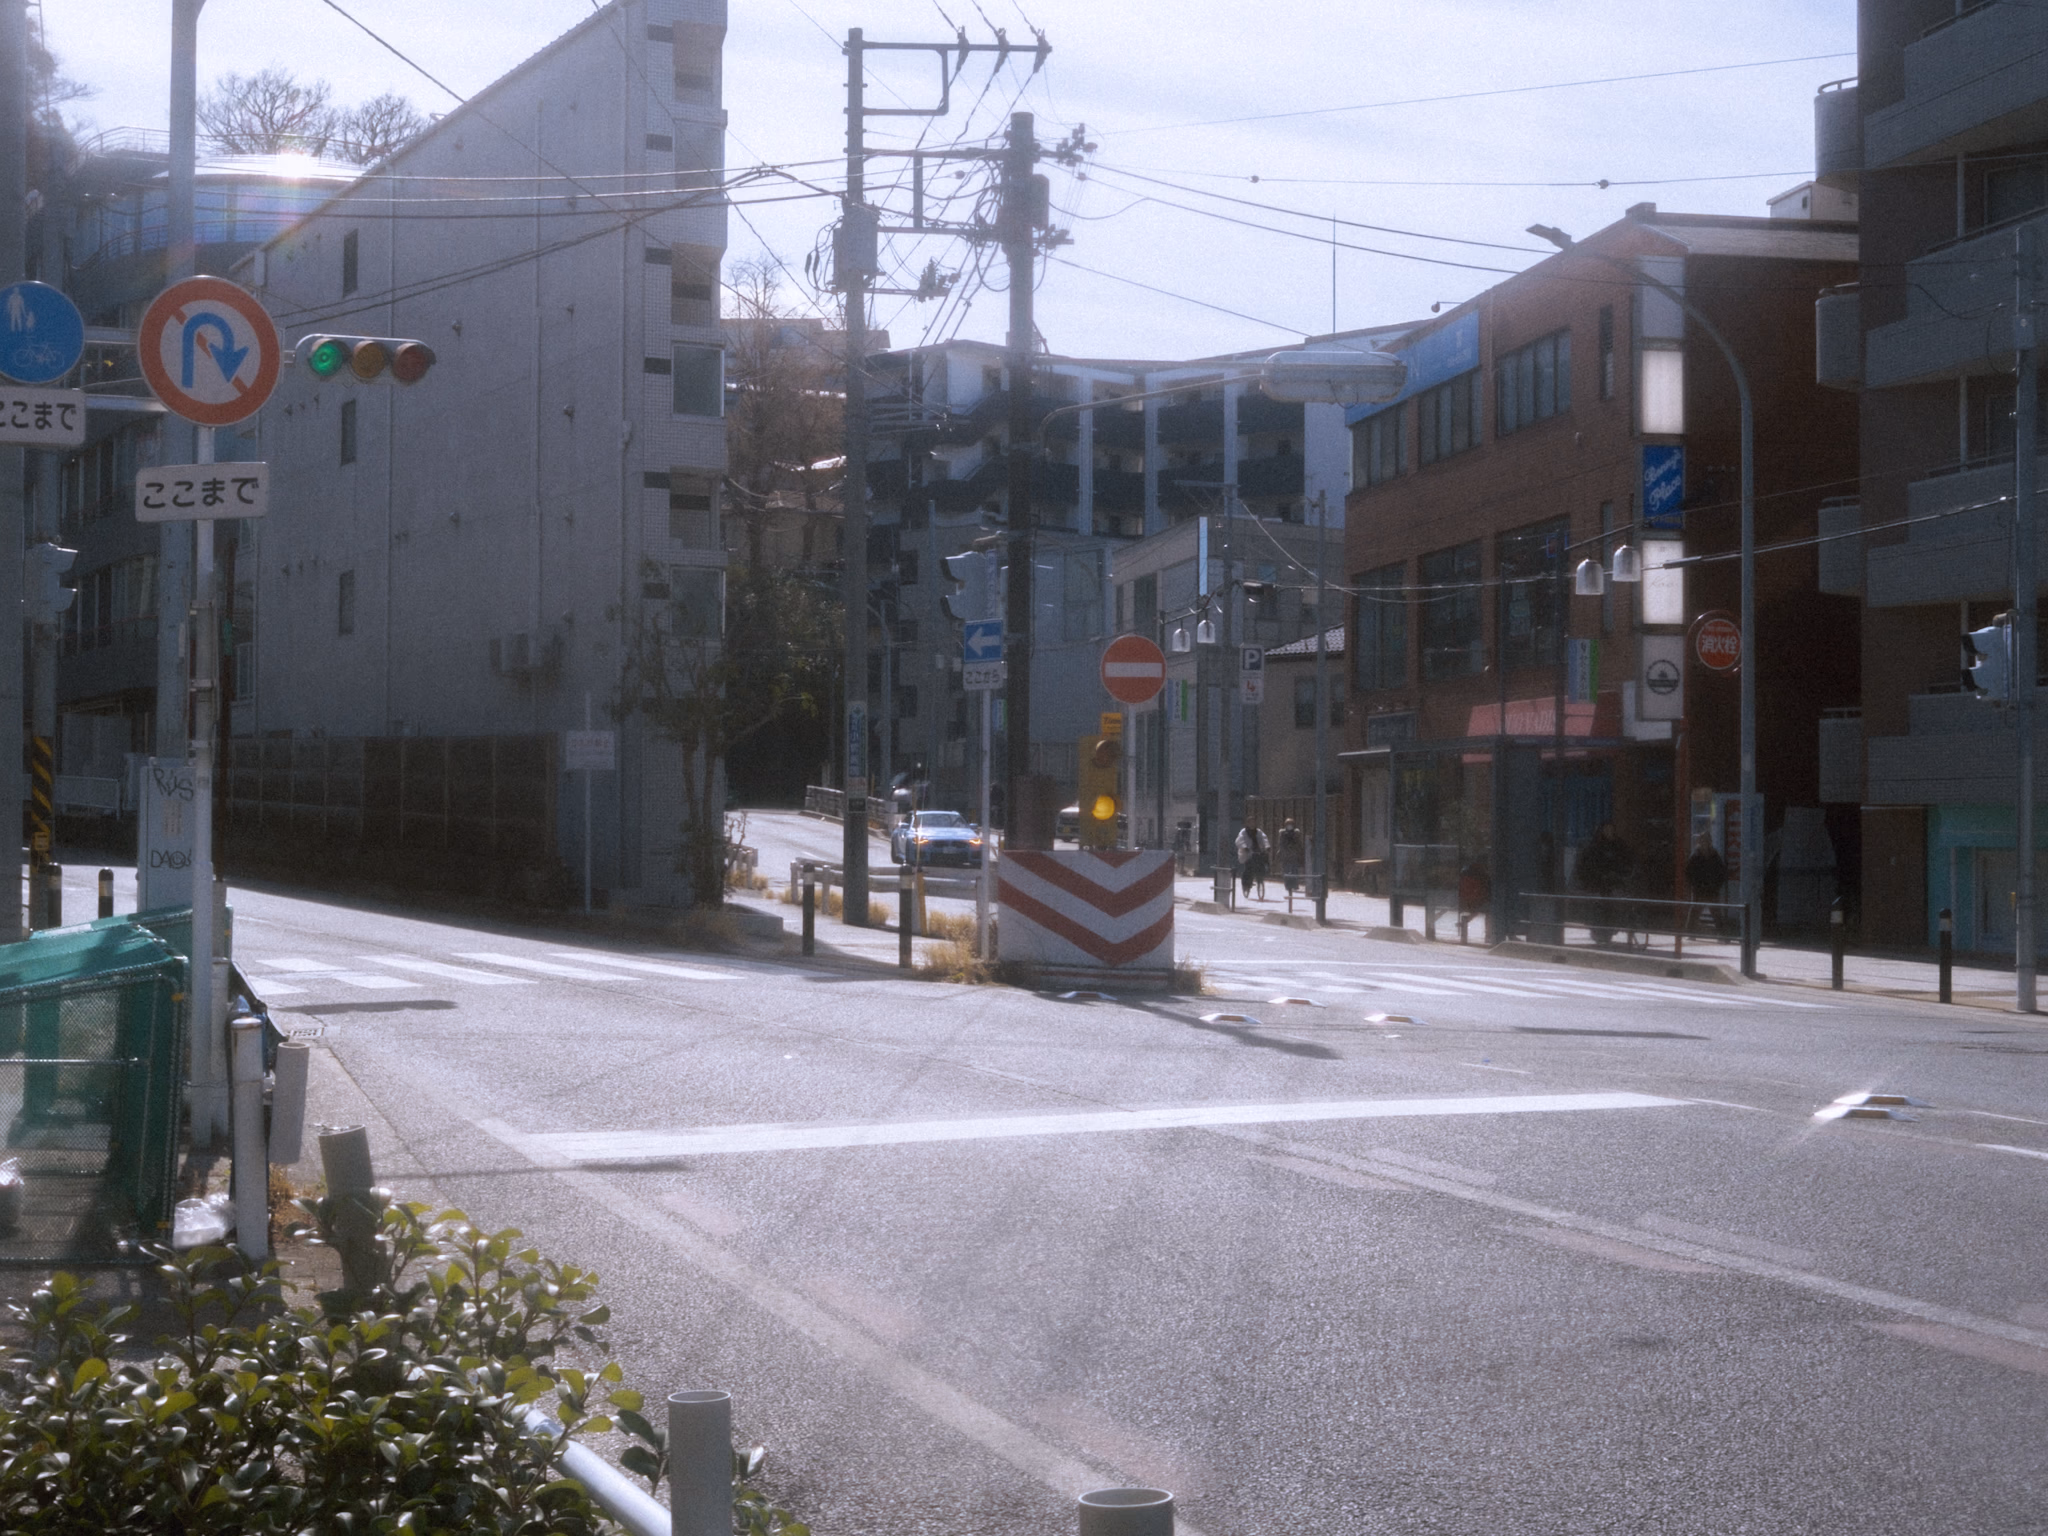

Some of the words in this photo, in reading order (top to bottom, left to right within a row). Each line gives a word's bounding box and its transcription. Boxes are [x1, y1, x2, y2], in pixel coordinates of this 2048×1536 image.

[143, 477, 260, 509] ここまで
[1701, 634, 1738, 655] 消火栓
[1244, 649, 1260, 669] P
[965, 669, 1000, 685] ここから
